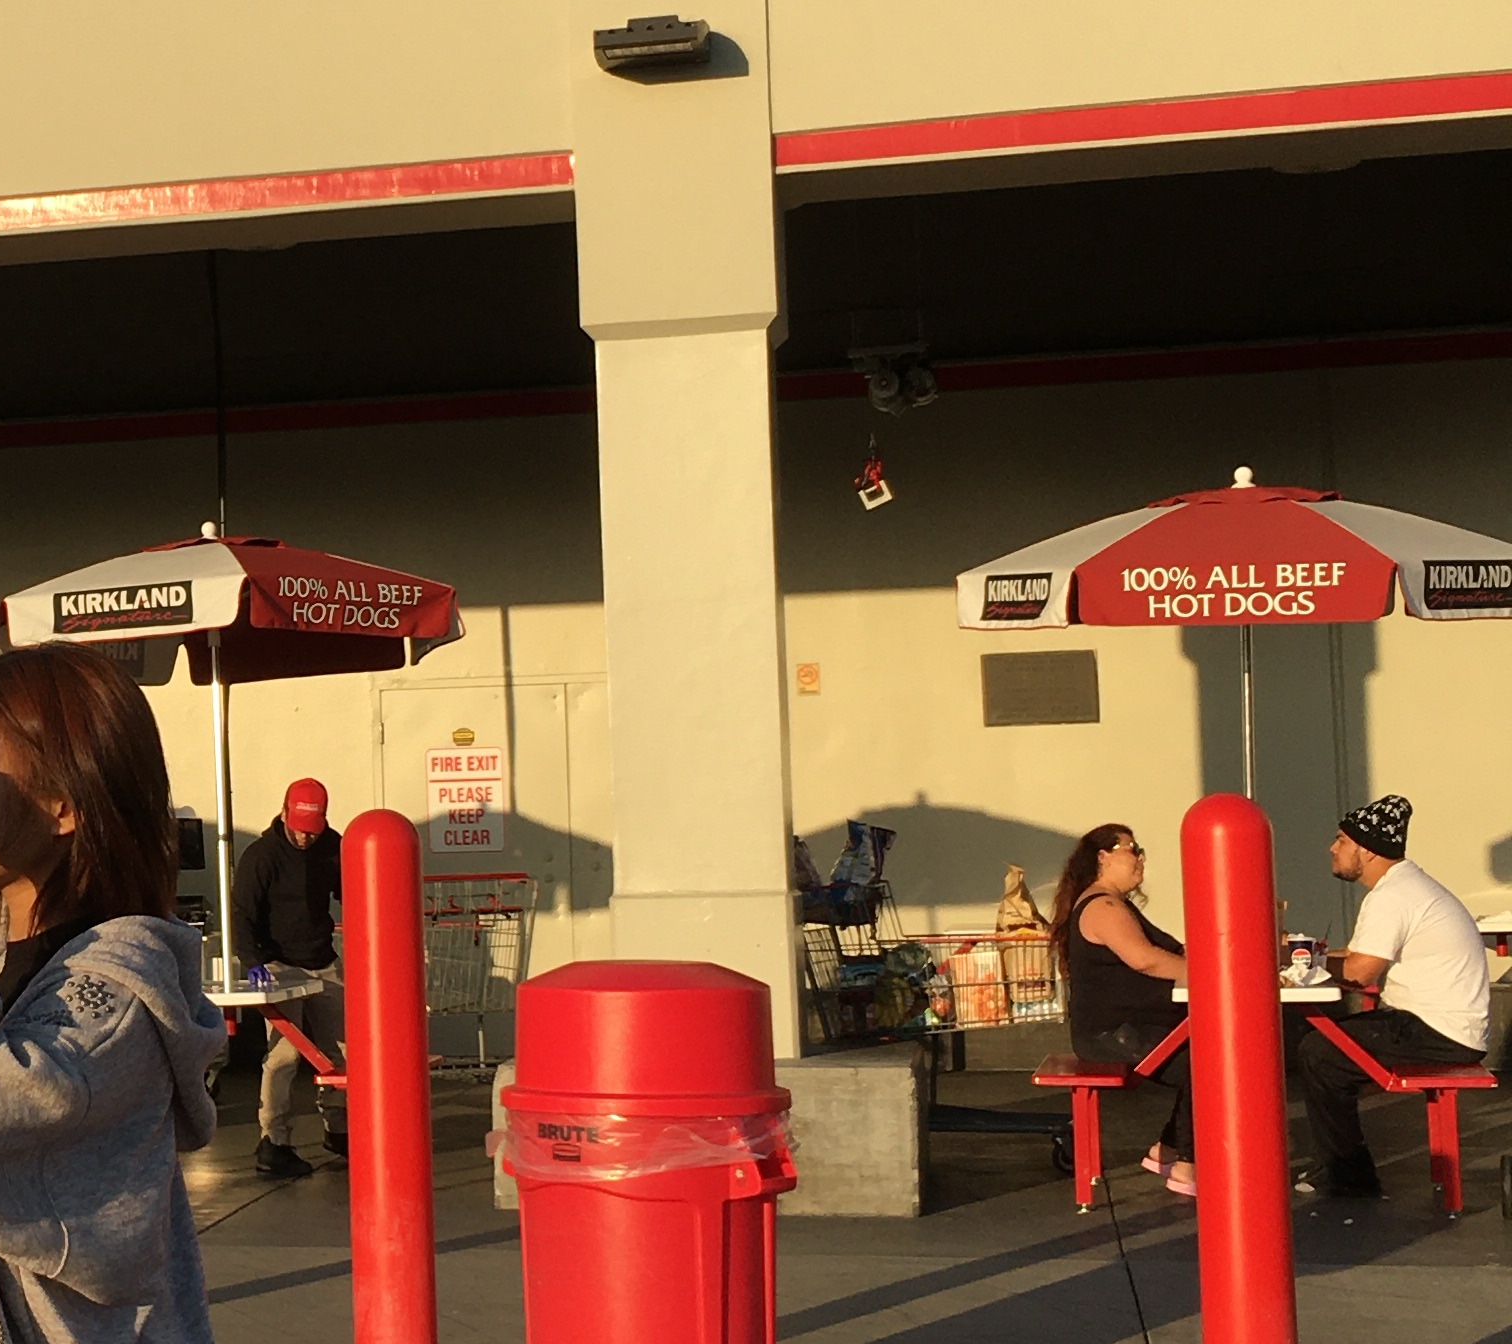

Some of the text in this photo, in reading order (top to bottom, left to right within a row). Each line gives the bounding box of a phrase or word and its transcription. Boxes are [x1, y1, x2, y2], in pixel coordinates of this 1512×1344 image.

[1120, 562, 1347, 592] 100% ALL BEEF
[1429, 564, 1512, 589] KIRKLAND
[60, 585, 187, 617] KIRKLAND
[277, 576, 423, 606] 100% ALL BEEF
[988, 578, 1049, 602] KIRKLAND
[292, 601, 400, 629] HOT DOGS
[1148, 590, 1316, 618] HOT DOGS
[431, 755, 498, 772] FIRE EXIT
[439, 786, 493, 803] PLEASE
[448, 808, 485, 824] KEEP
[444, 830, 491, 846] CLEAR
[538, 1122, 599, 1144] BRUTE
